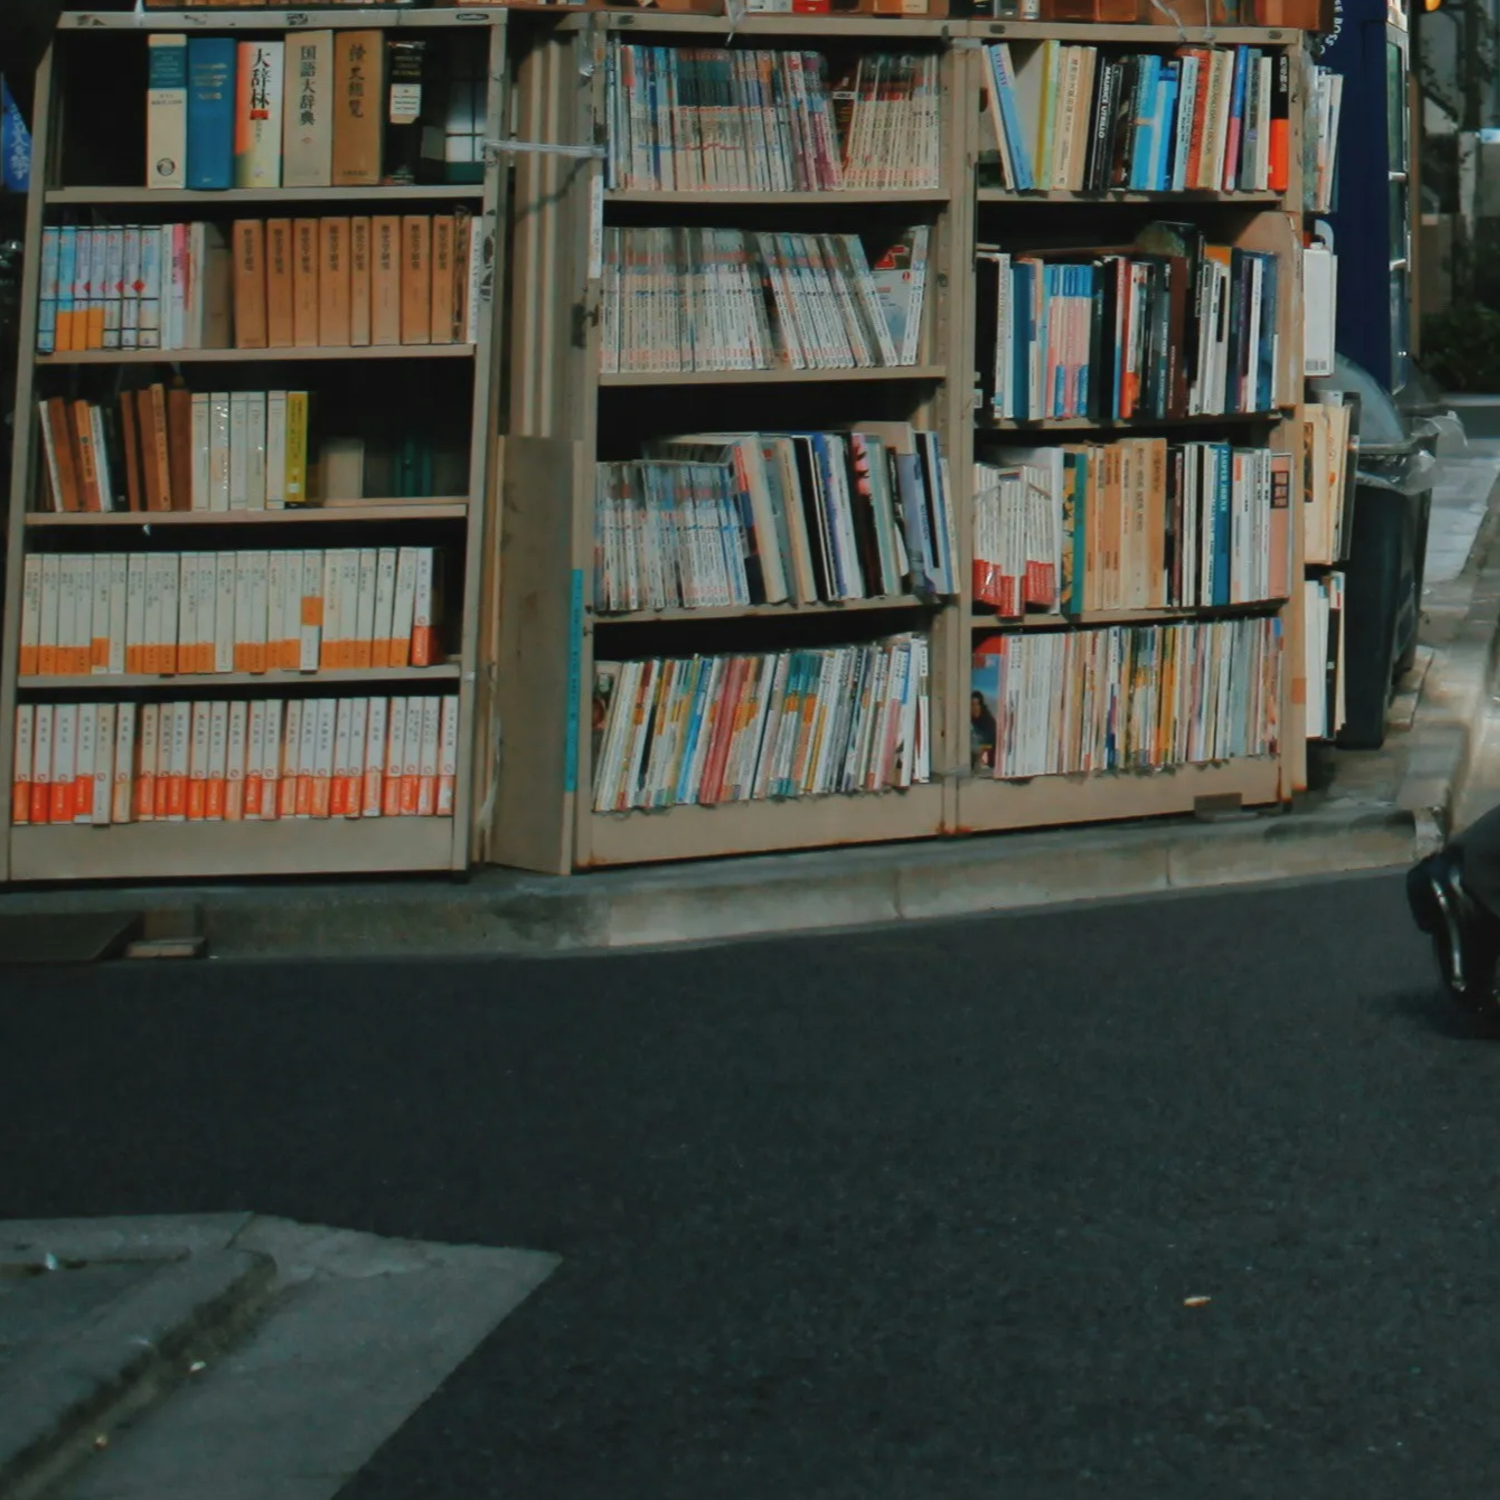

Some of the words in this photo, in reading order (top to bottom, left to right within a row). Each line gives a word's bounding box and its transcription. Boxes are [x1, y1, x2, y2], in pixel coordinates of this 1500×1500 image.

[249, 47, 272, 110] 大辞林
[299, 45, 318, 127] 国語大辞典
